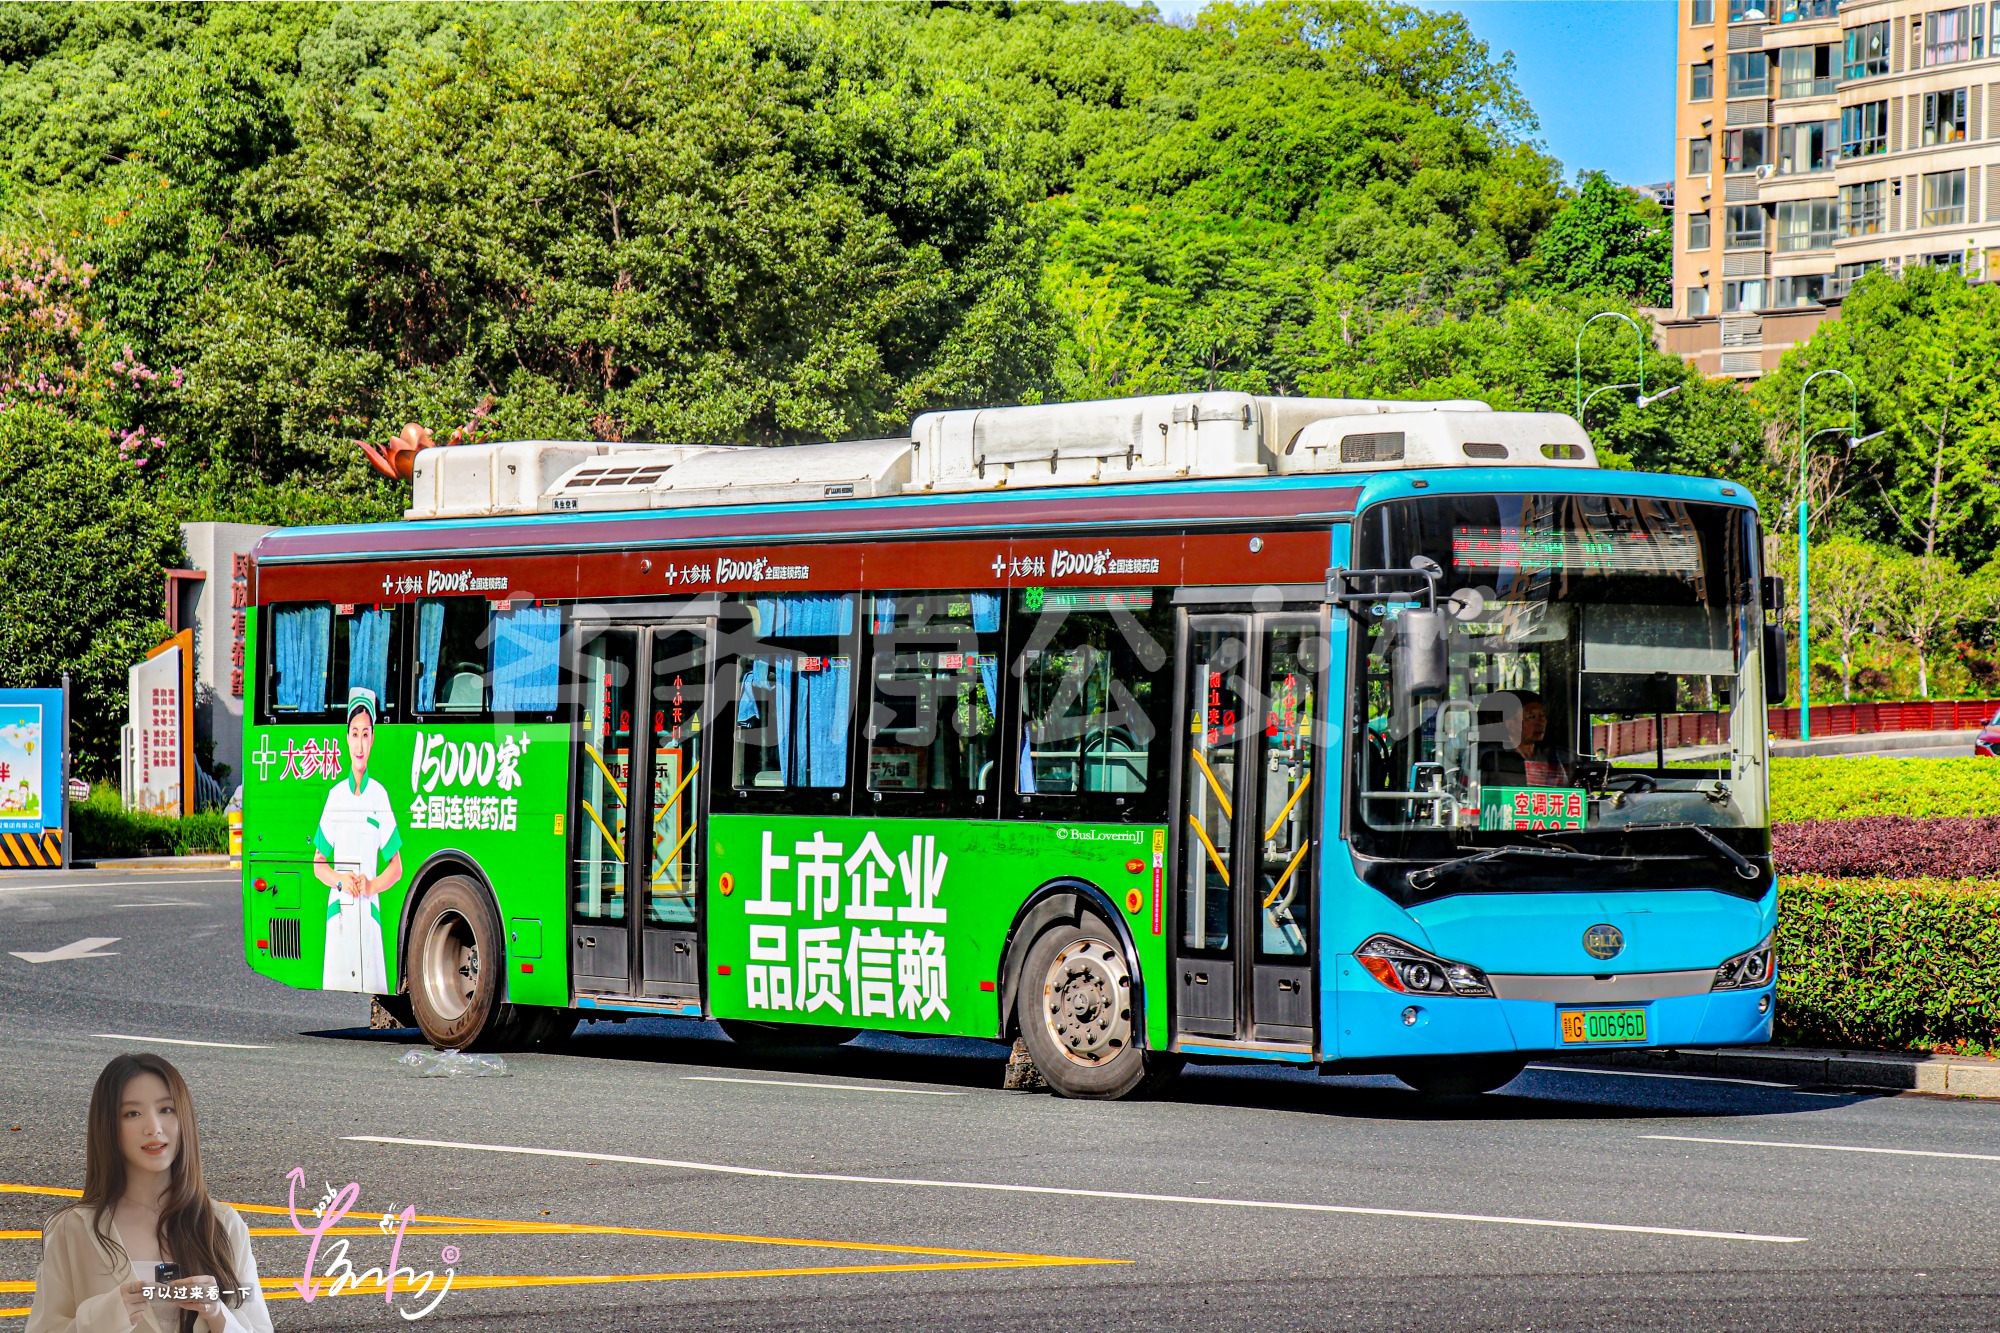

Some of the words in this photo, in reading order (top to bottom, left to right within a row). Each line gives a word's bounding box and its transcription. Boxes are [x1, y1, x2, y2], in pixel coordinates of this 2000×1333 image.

[680, 564, 711, 585] 大参林
[765, 565, 809, 580] 全国连锁药店
[1010, 556, 1045, 577] 大参林
[1108, 558, 1159, 574] 全国连锁药店
[395, 575, 423, 594] 大参林
[470, 577, 508, 590] 全国连锁药店
[280, 738, 342, 780] 大参林
[410, 795, 518, 831] 全国连锁药店
[1514, 792, 1581, 817] 空调开启
[744, 830, 949, 924] 上市企业
[1589, 934, 1621, 948] BLK
[745, 924, 951, 1022] 品质信赖
